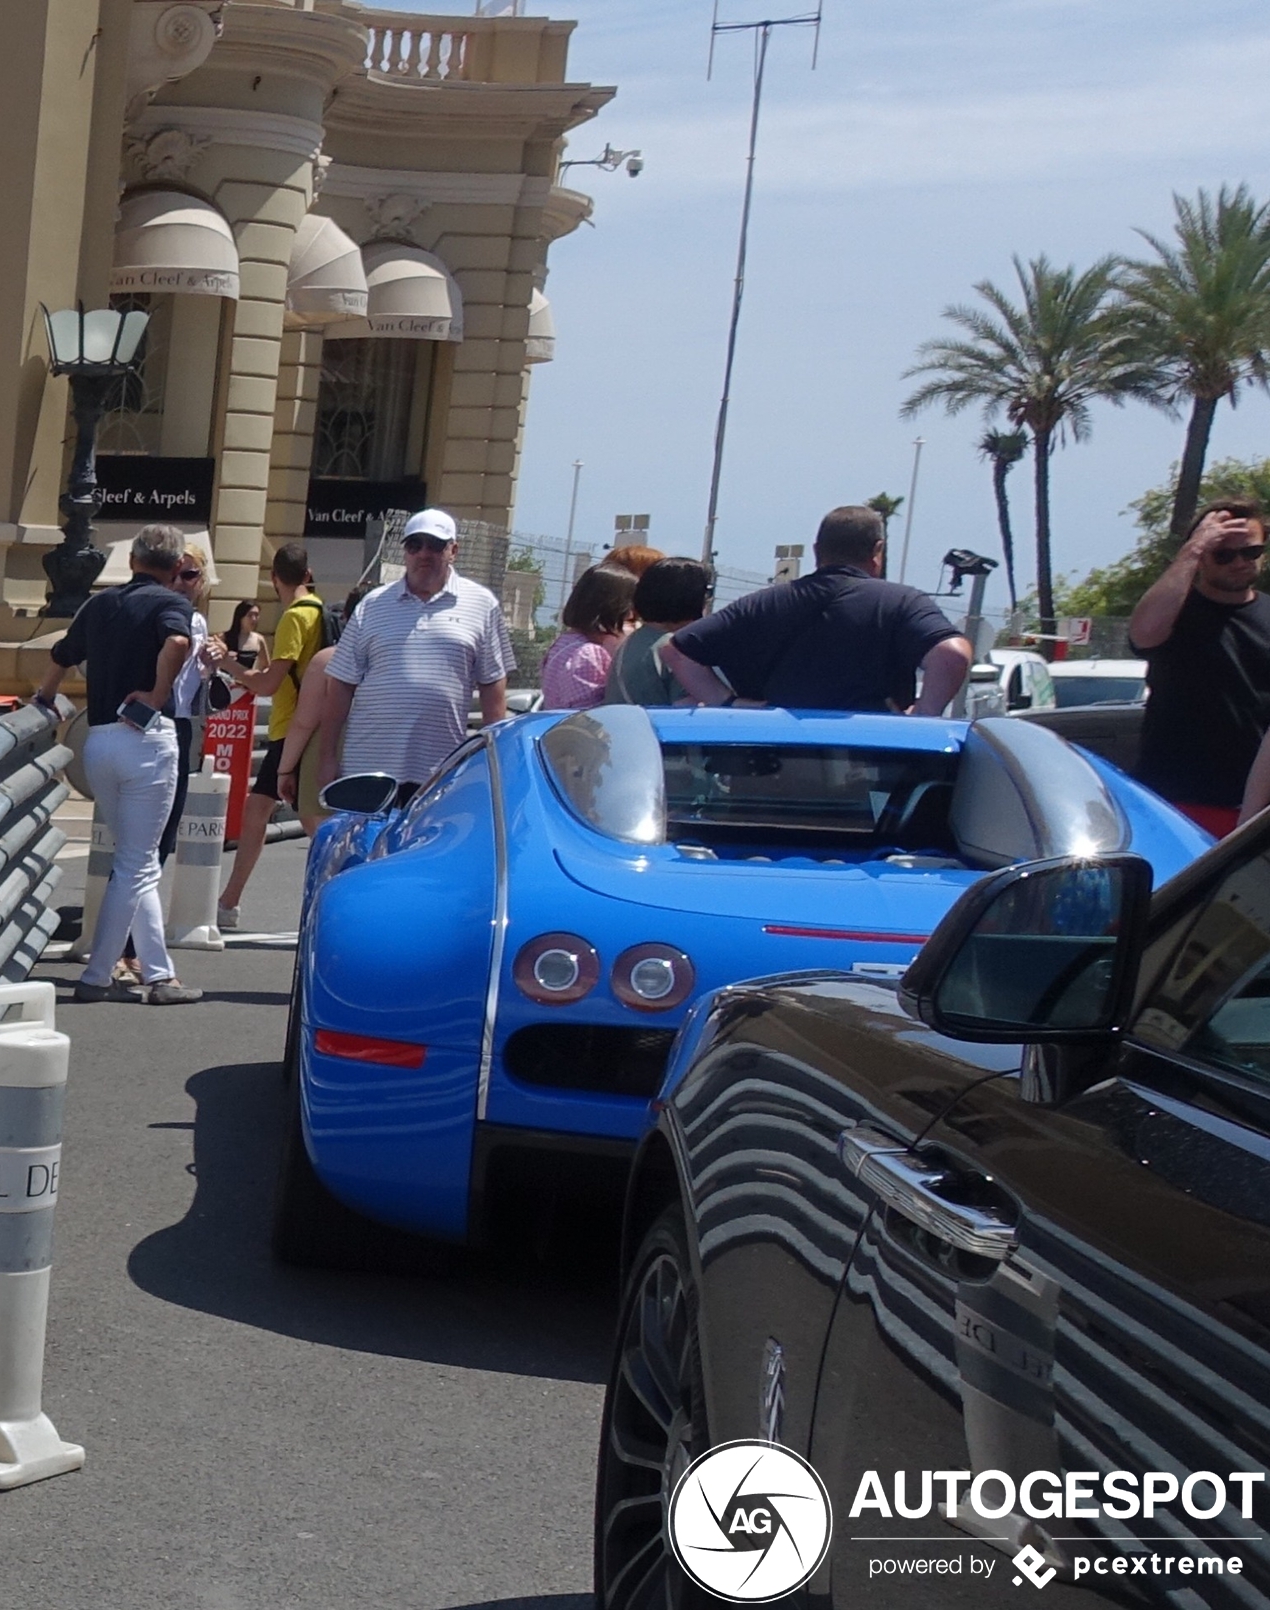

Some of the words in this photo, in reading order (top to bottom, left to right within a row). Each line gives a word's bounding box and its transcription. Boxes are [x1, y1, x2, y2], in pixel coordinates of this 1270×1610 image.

[140, 271, 184, 285] Cleef
[398, 319, 434, 333] Cleef
[133, 492, 145, 504] &
[149, 489, 196, 509] Arpels
[308, 508, 329, 522] Van
[331, 508, 365, 523] Cleef
[208, 723, 247, 739] 2022
[26, 1160, 59, 1198] DE
